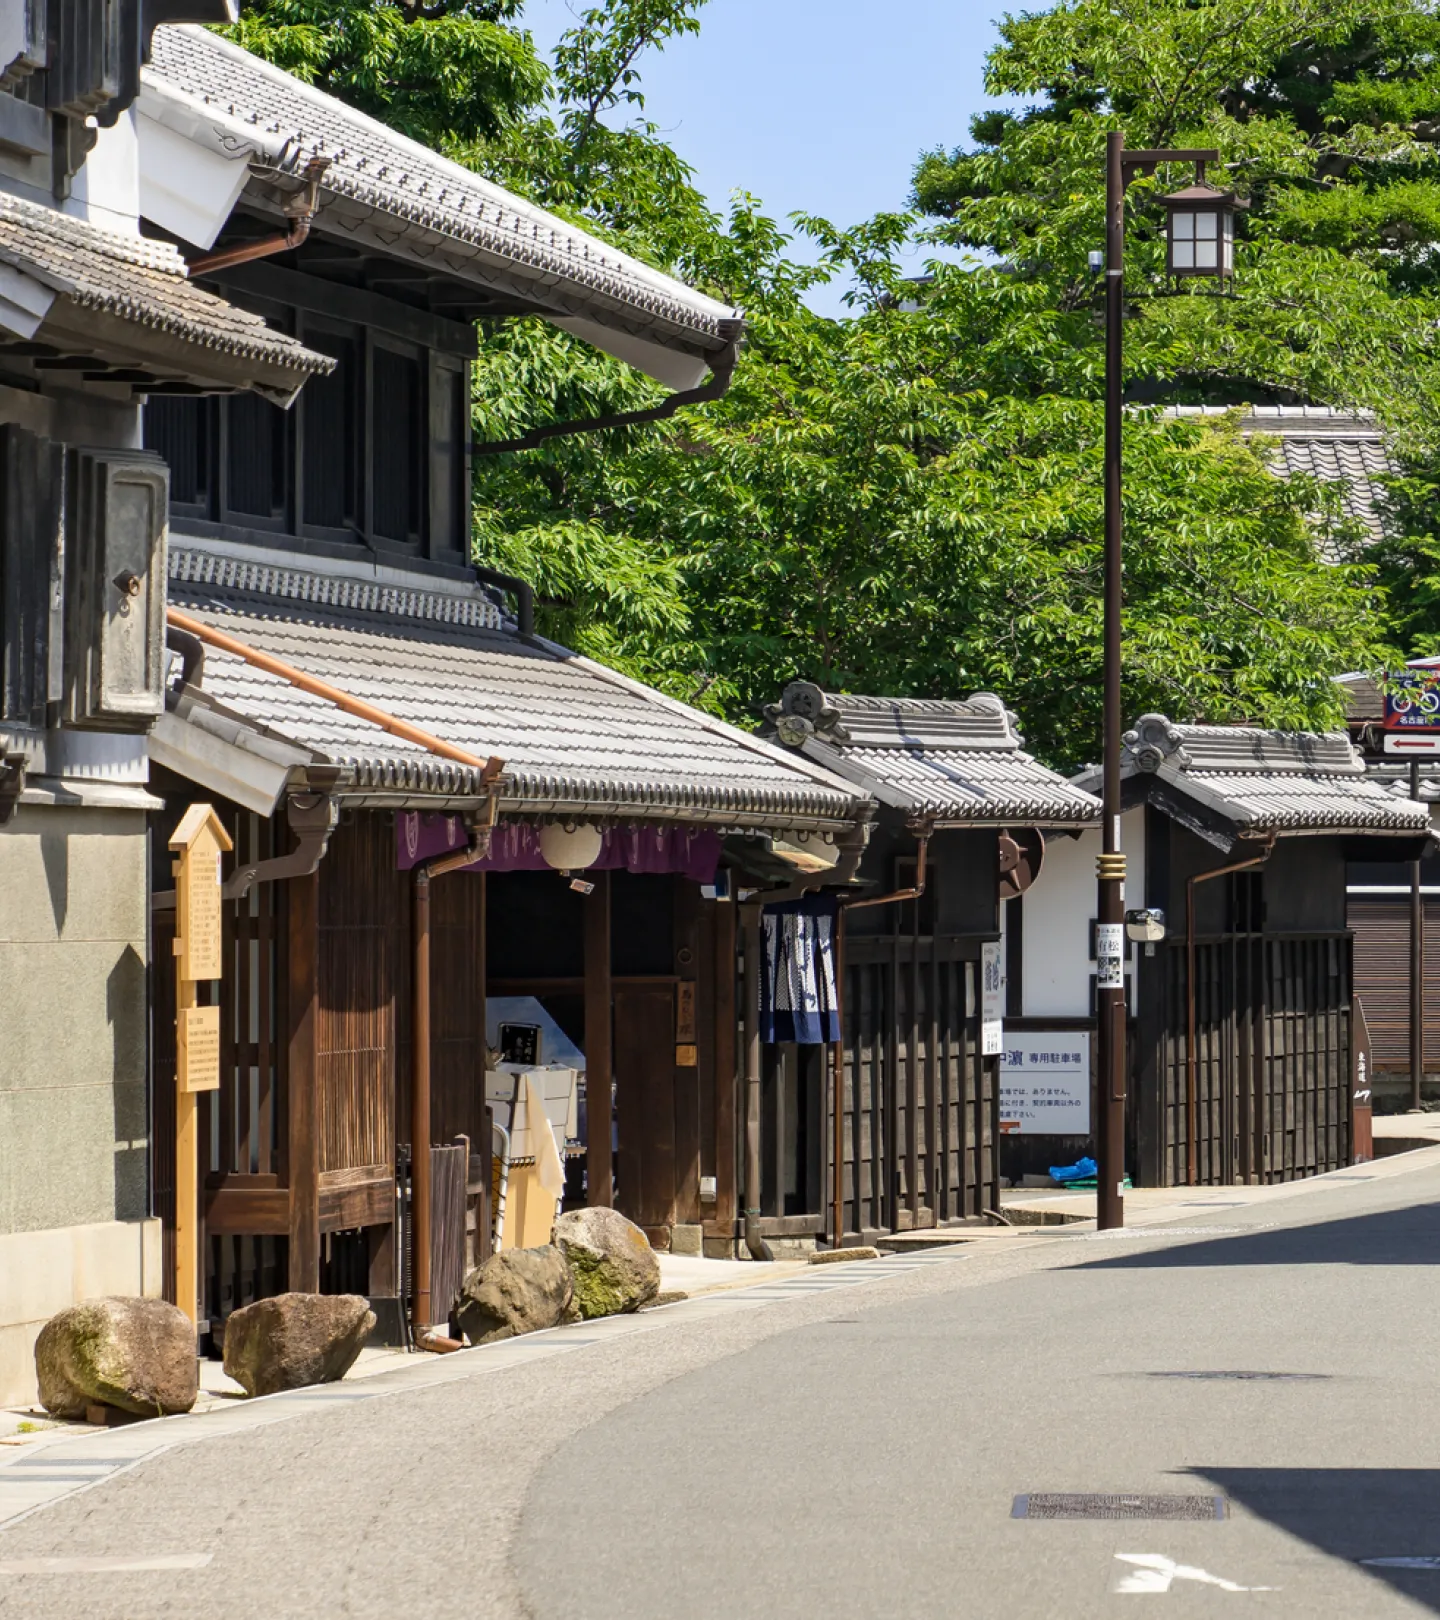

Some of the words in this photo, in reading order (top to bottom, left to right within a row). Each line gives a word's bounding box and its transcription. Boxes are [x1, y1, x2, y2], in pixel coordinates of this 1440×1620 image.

[1029, 1052, 1082, 1064] 専用駐車場
